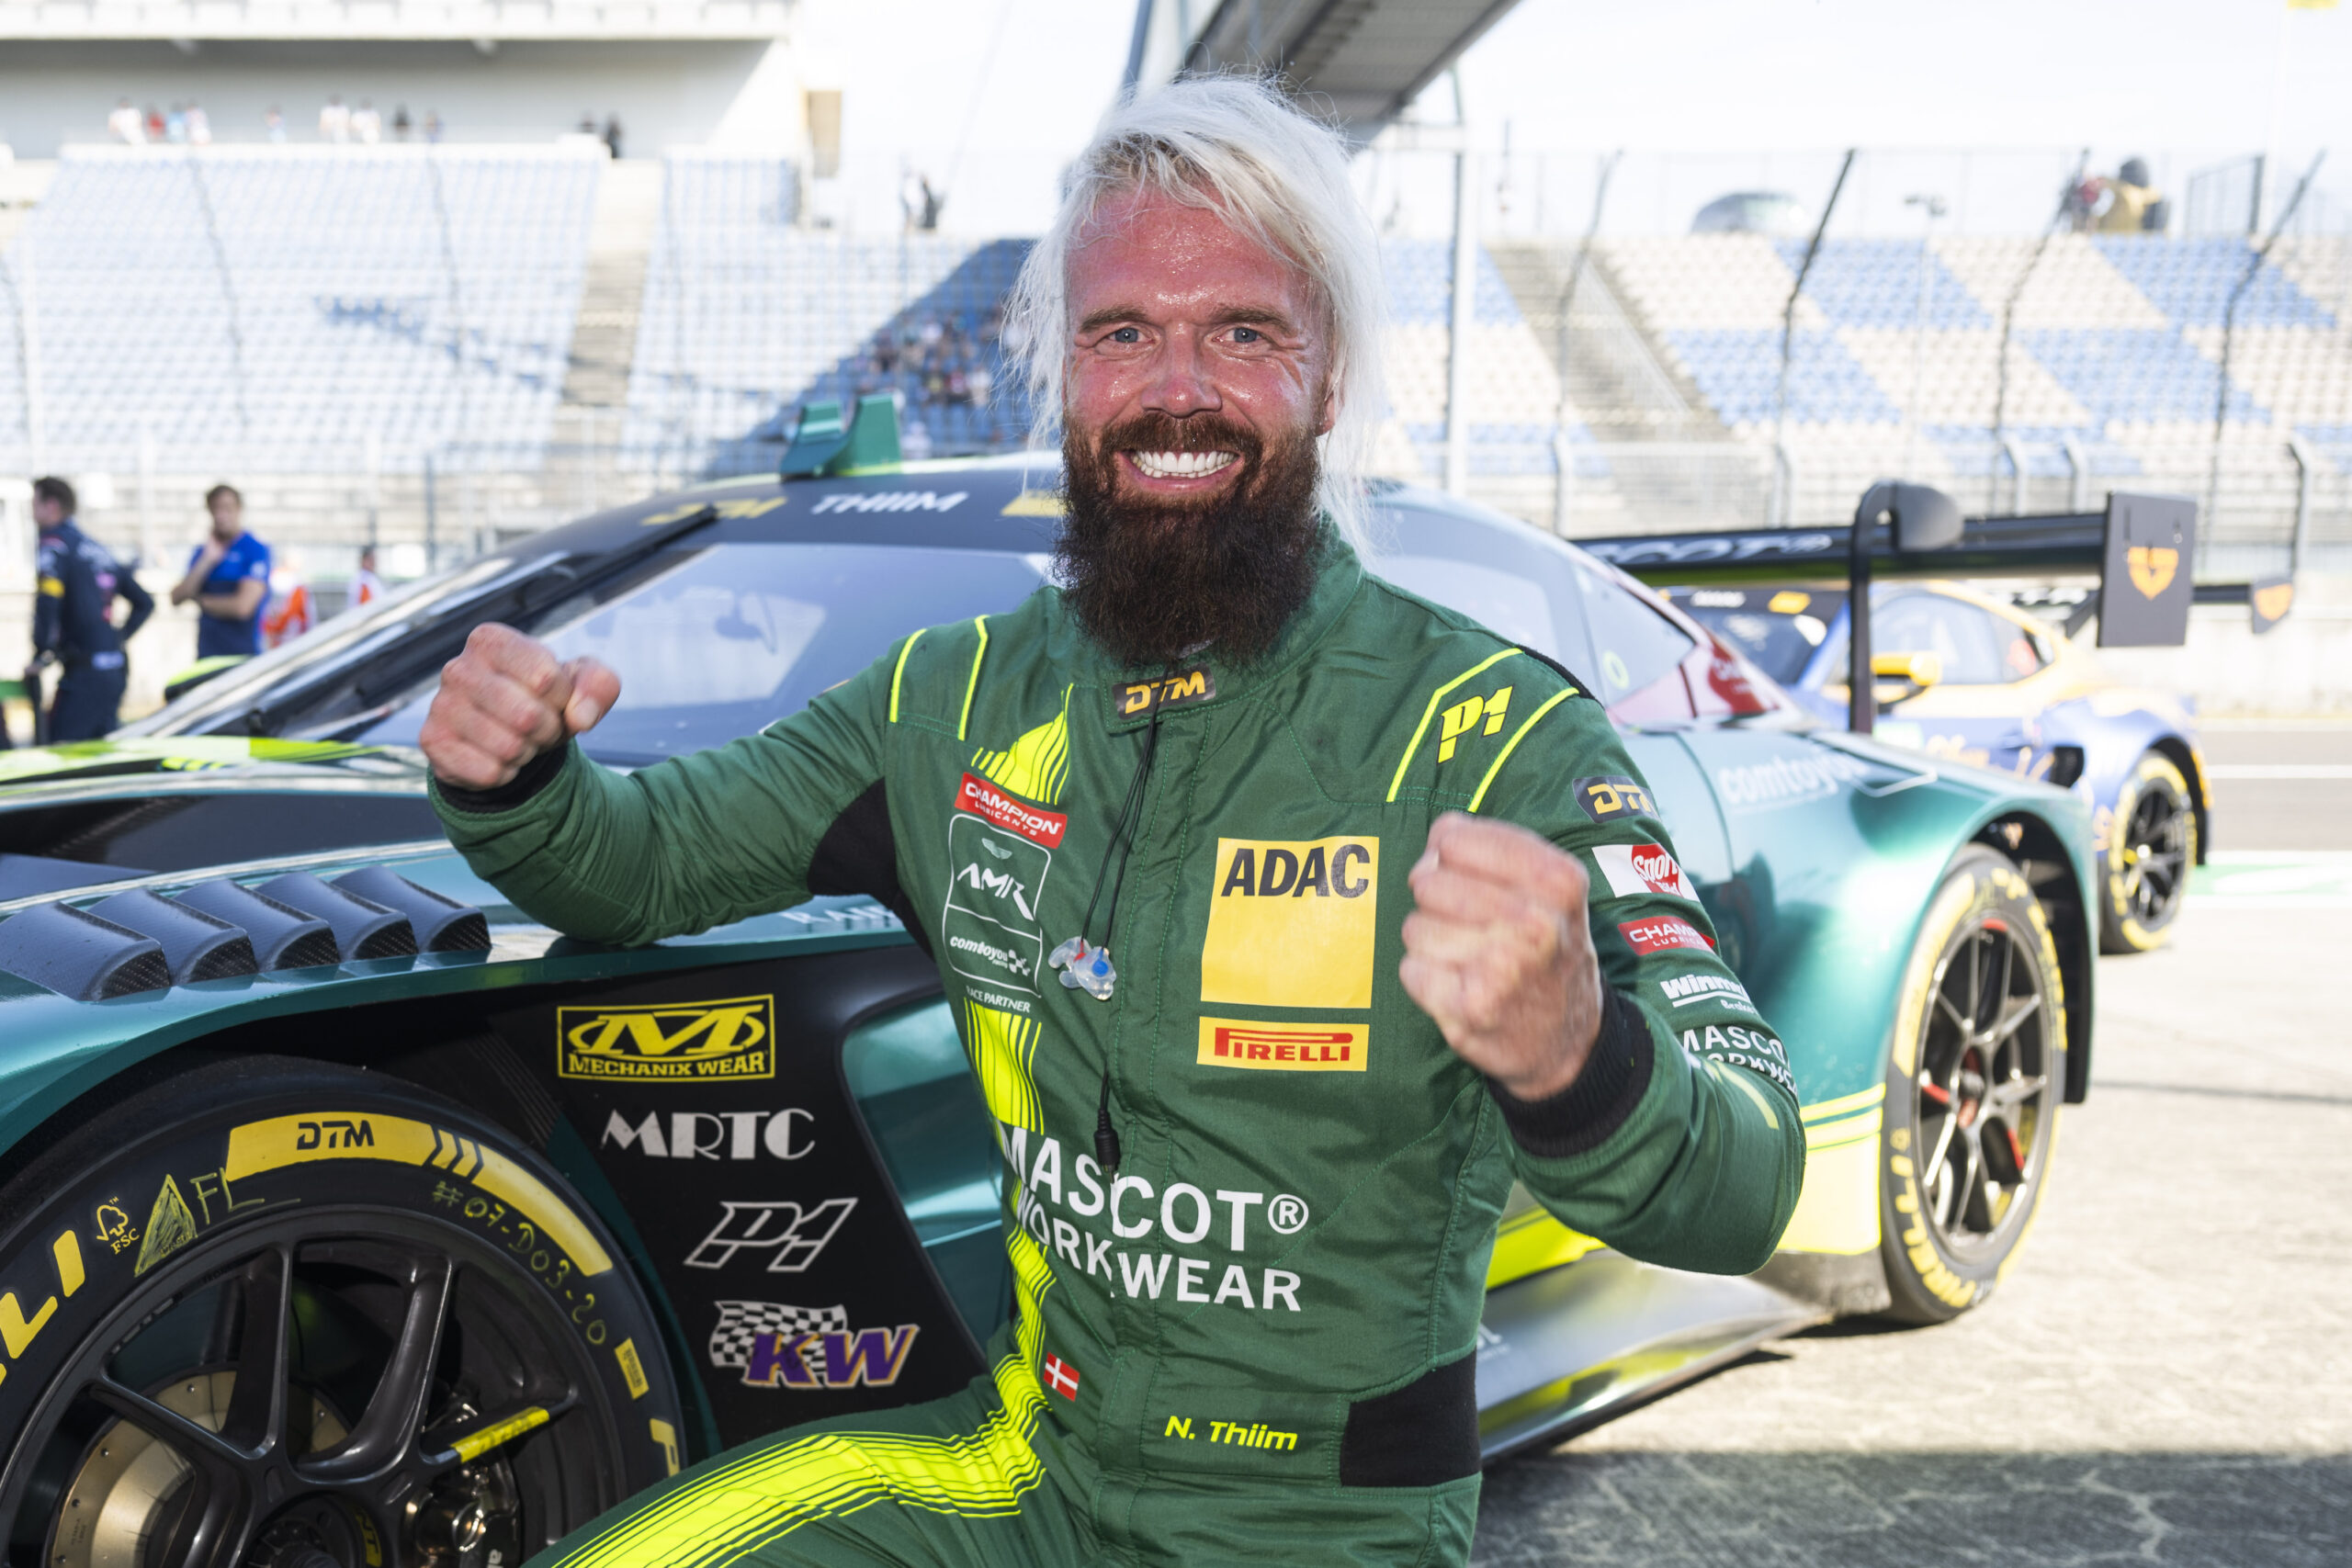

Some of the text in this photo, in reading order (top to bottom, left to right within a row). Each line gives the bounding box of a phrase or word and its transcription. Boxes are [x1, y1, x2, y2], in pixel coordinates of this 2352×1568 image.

[812, 491, 969, 514] THIIM
[1125, 671, 1206, 715] DTM
[1437, 685, 1513, 764] P1
[965, 782, 1063, 835] CHAMPION
[975, 801, 1037, 837] LUBRICANTS
[1221, 843, 1371, 898] ADAC
[950, 935, 1009, 962] comtoyou
[984, 992, 1032, 1013] PARTNER
[1214, 1026, 1354, 1063] PIRELLI
[568, 1052, 766, 1077] MECHANIX WEAR
[296, 1119, 375, 1150] DTM
[600, 1108, 816, 1160] MRTC
[110, 1227, 141, 1256] FSC
[683, 1197, 859, 1273] P1
[0, 1229, 86, 1387] LI
[741, 1324, 921, 1389] KW
[1164, 1416, 1298, 1450] N. Thiim
